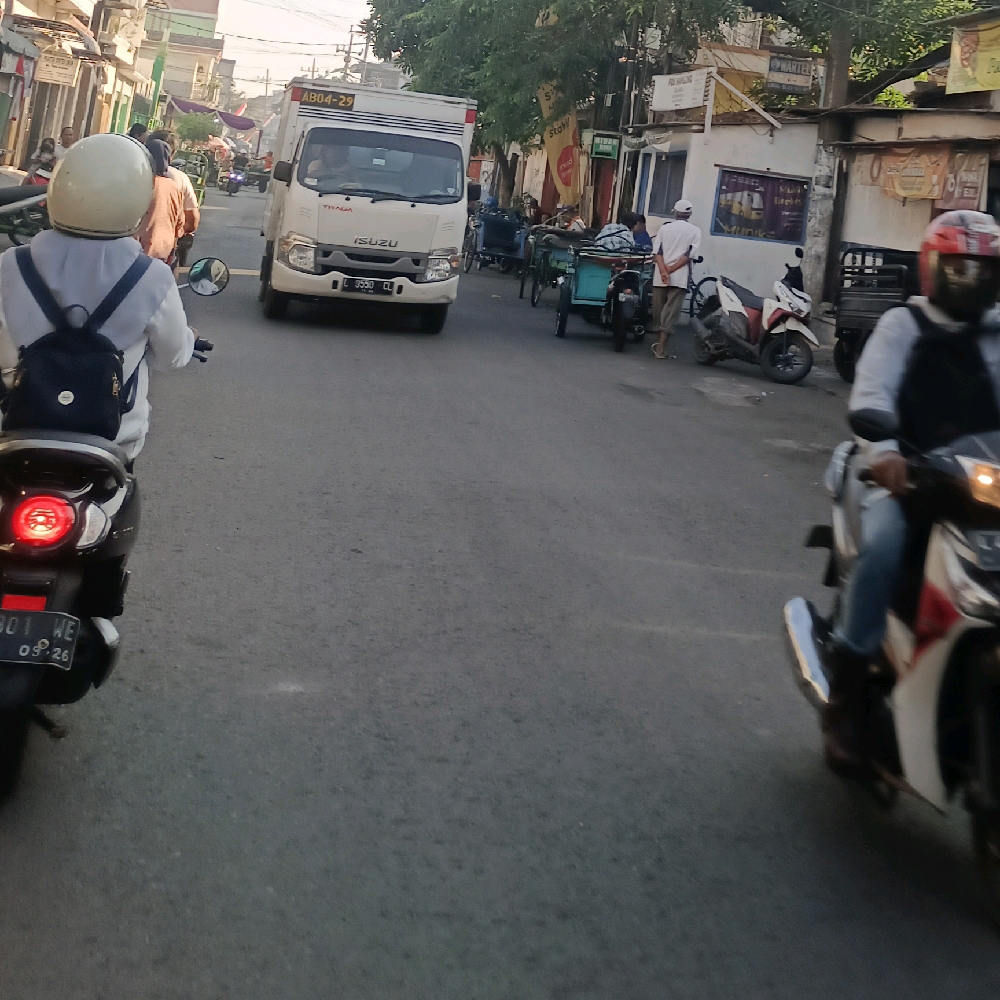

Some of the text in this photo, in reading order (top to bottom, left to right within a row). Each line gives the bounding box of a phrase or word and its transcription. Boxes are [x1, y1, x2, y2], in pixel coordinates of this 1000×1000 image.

[302, 90, 354, 107] AB04-29
[353, 236, 399, 248] ISUZU
[344, 279, 349, 287] L
